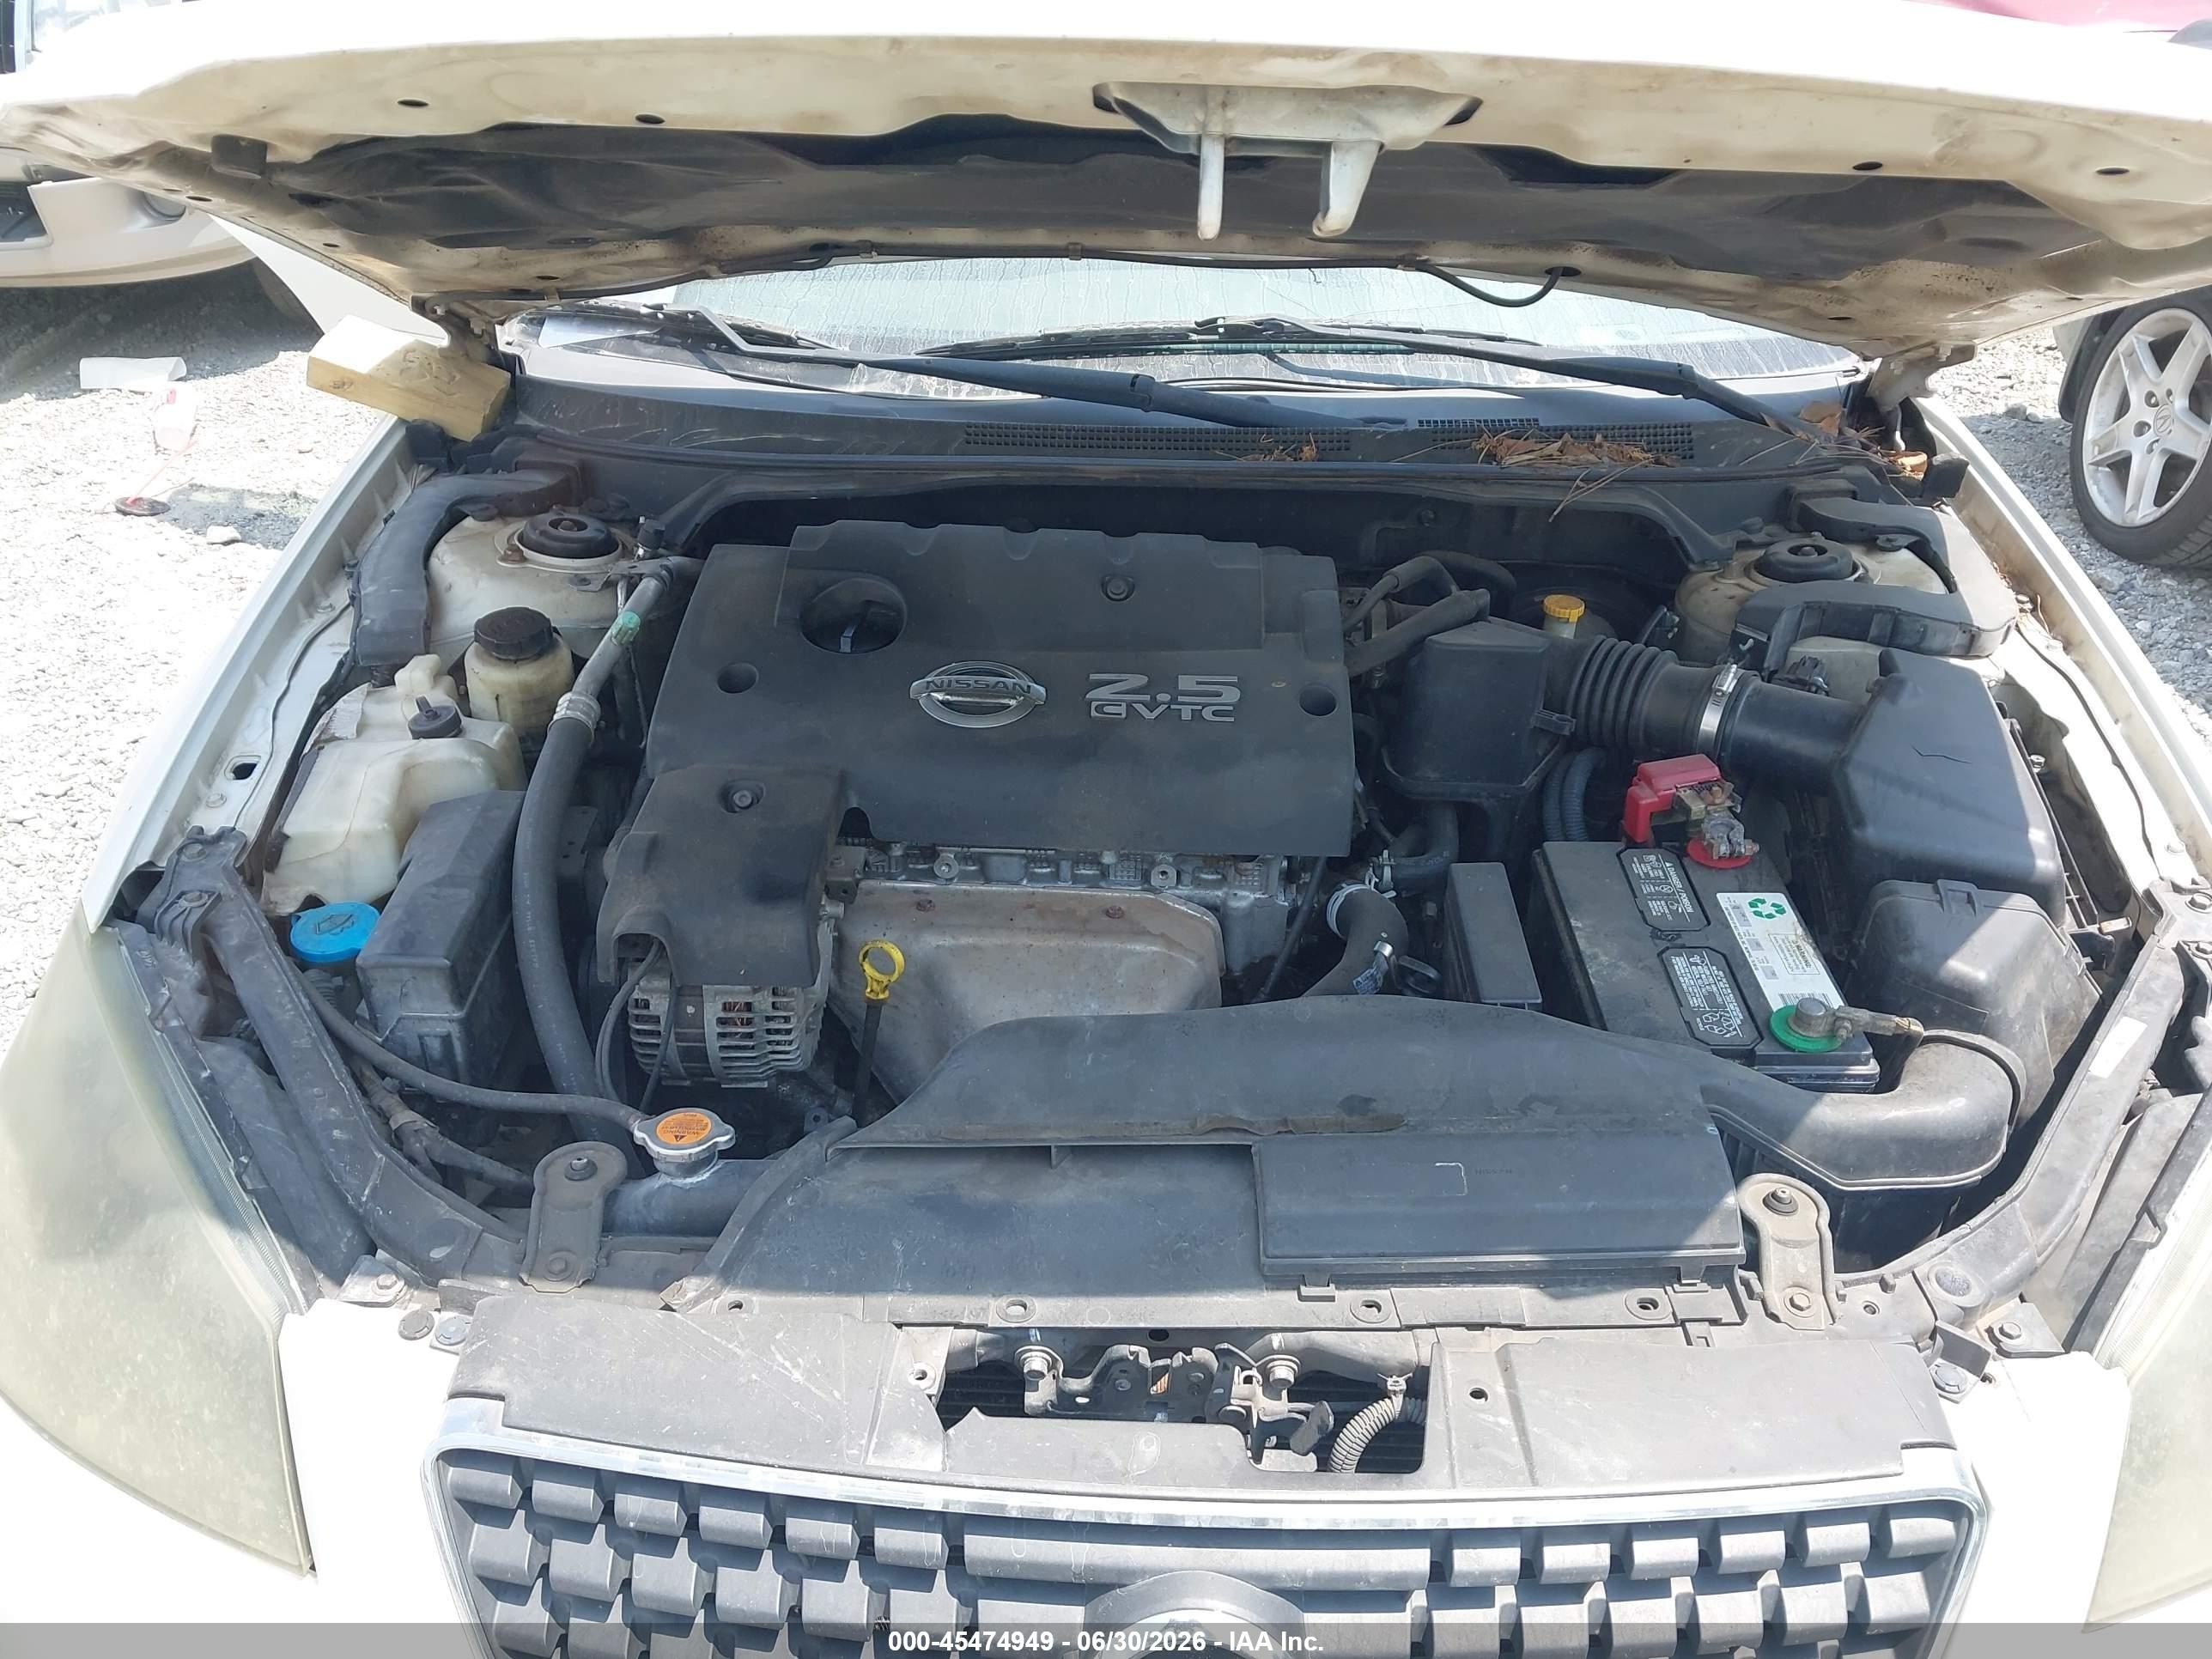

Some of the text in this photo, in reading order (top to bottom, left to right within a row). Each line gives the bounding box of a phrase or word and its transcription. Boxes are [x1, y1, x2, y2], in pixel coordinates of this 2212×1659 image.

[926, 679, 1031, 695] NISSAN
[1085, 673, 1241, 703] 2.5
[1091, 701, 1236, 722] CVTC
[1667, 867, 1682, 888] DANGER
[1679, 893, 1694, 913] POISON
